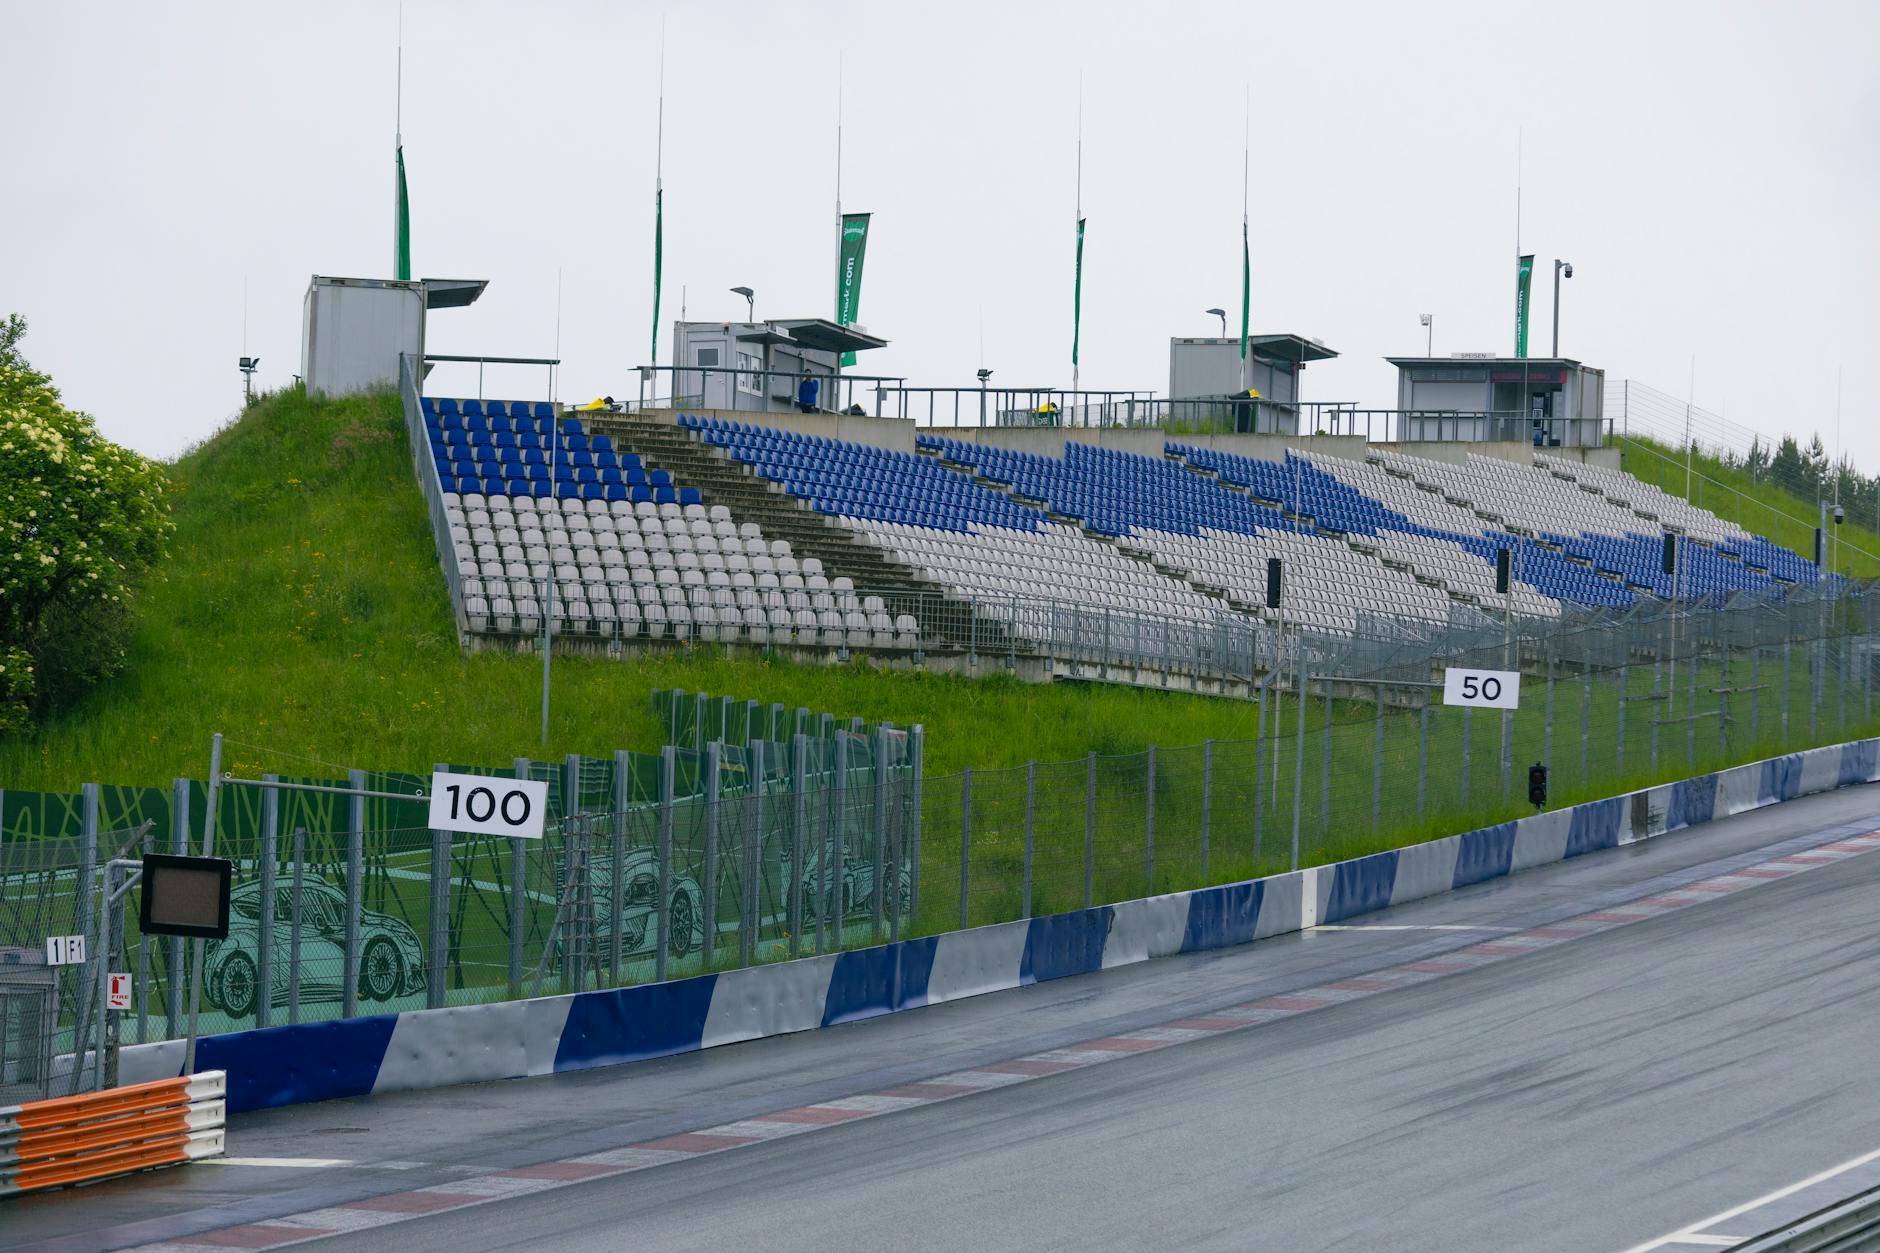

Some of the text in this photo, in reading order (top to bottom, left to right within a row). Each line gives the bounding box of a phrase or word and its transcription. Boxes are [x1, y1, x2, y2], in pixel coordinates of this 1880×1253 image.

[1462, 676, 1501, 700] 50
[446, 784, 531, 826] 100
[53, 938, 59, 963] 1
[69, 939, 82, 961] F1
